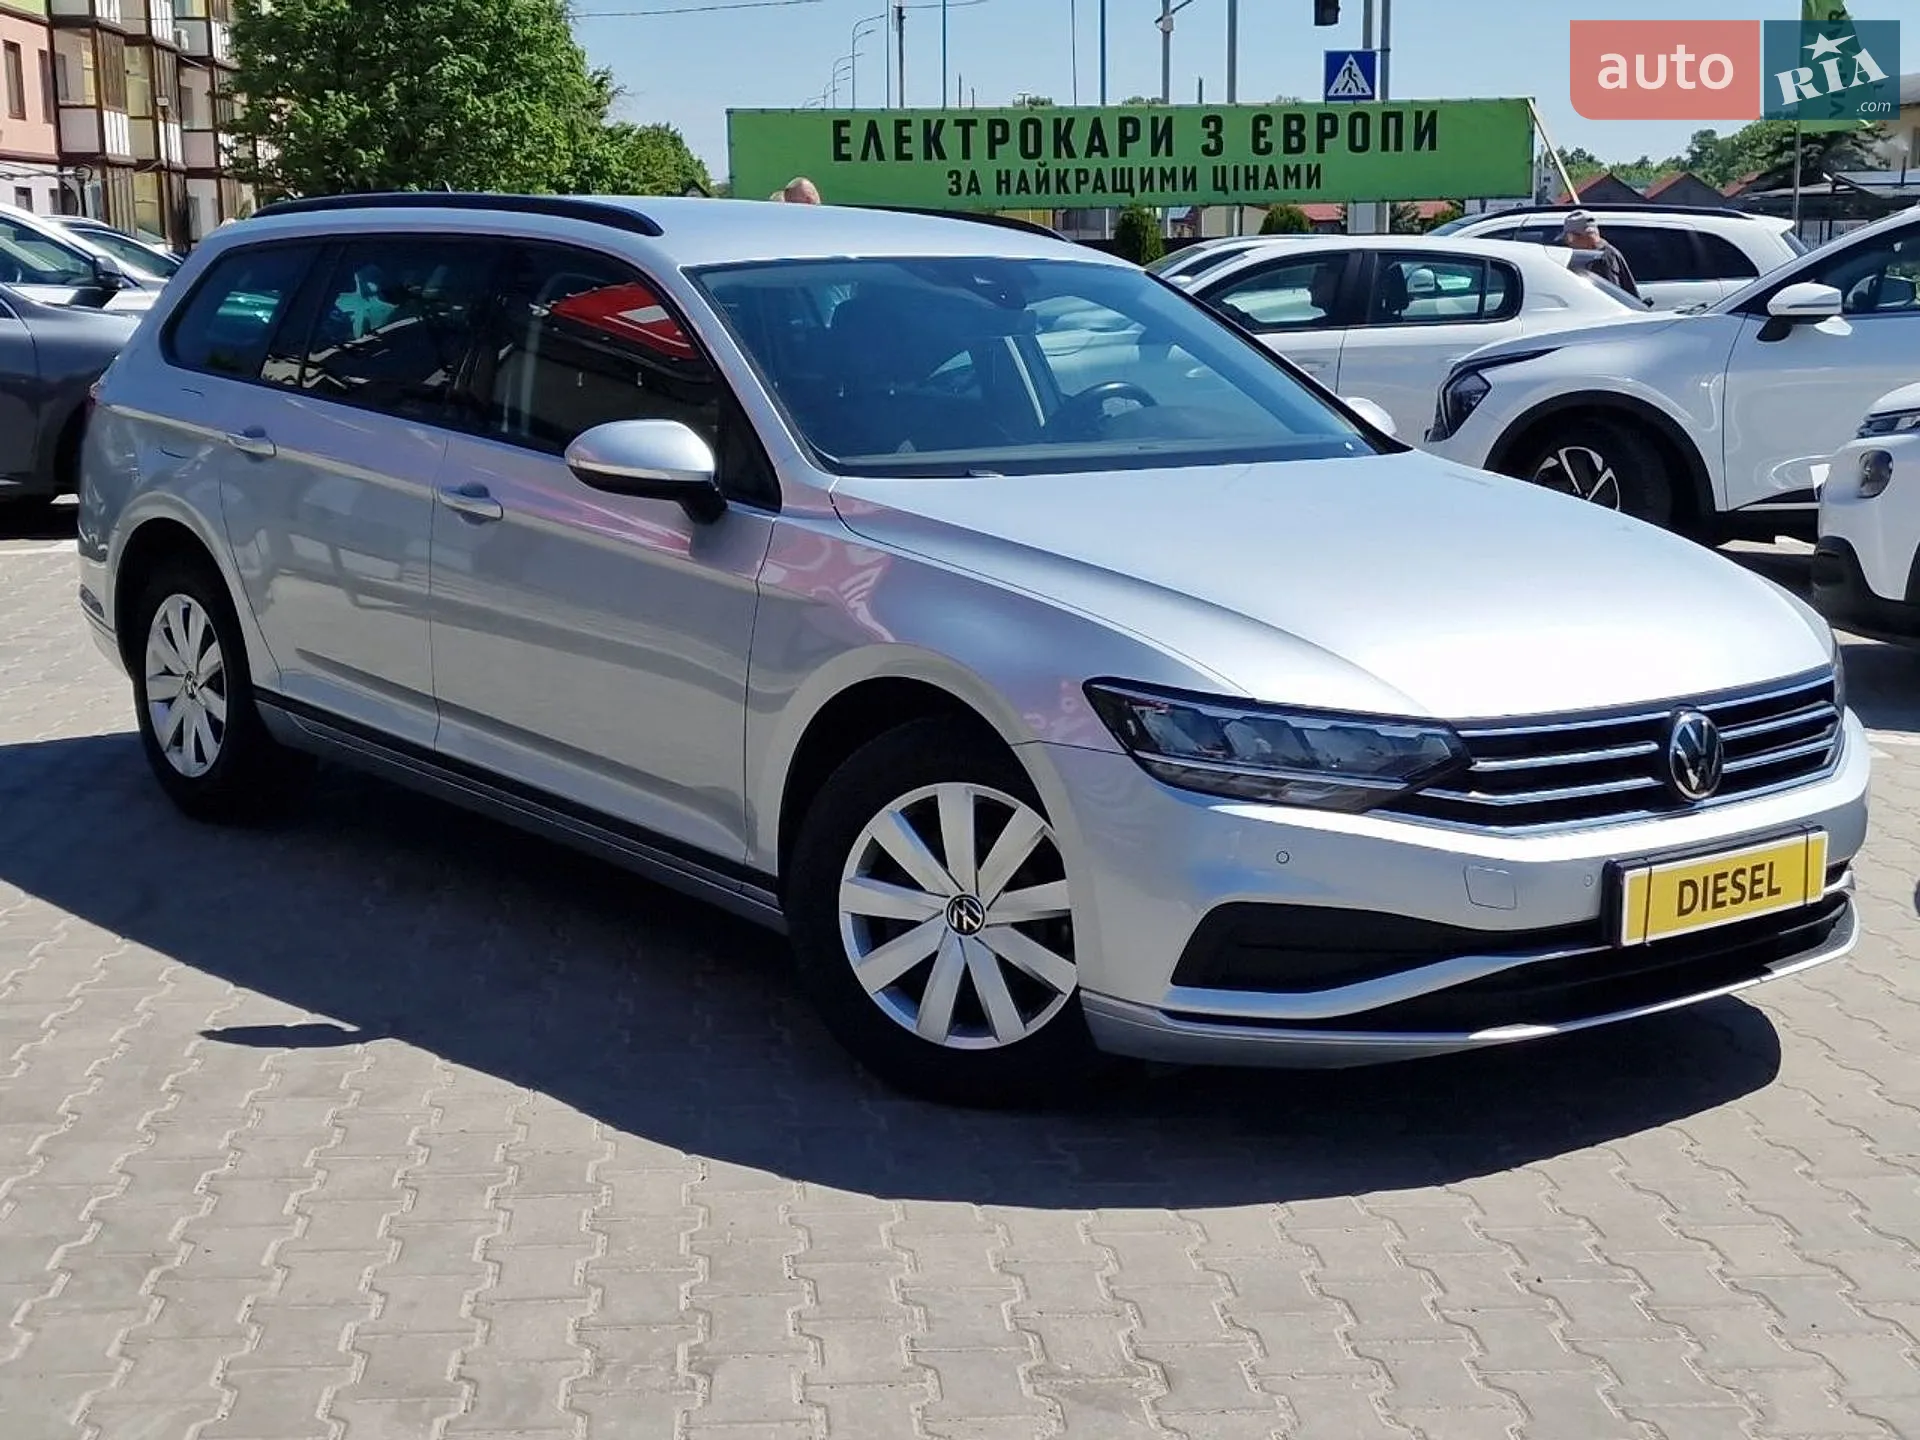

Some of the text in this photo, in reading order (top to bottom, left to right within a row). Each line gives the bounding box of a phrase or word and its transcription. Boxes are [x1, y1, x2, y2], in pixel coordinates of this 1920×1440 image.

[832, 109, 1438, 162] ЕЛЕКТРОКАРИ З ЄВРОПИ
[947, 161, 1321, 197] ЗА НАЙКРАЩИМИ ЦІНАМИ
[1676, 861, 1782, 918] DIESEL
